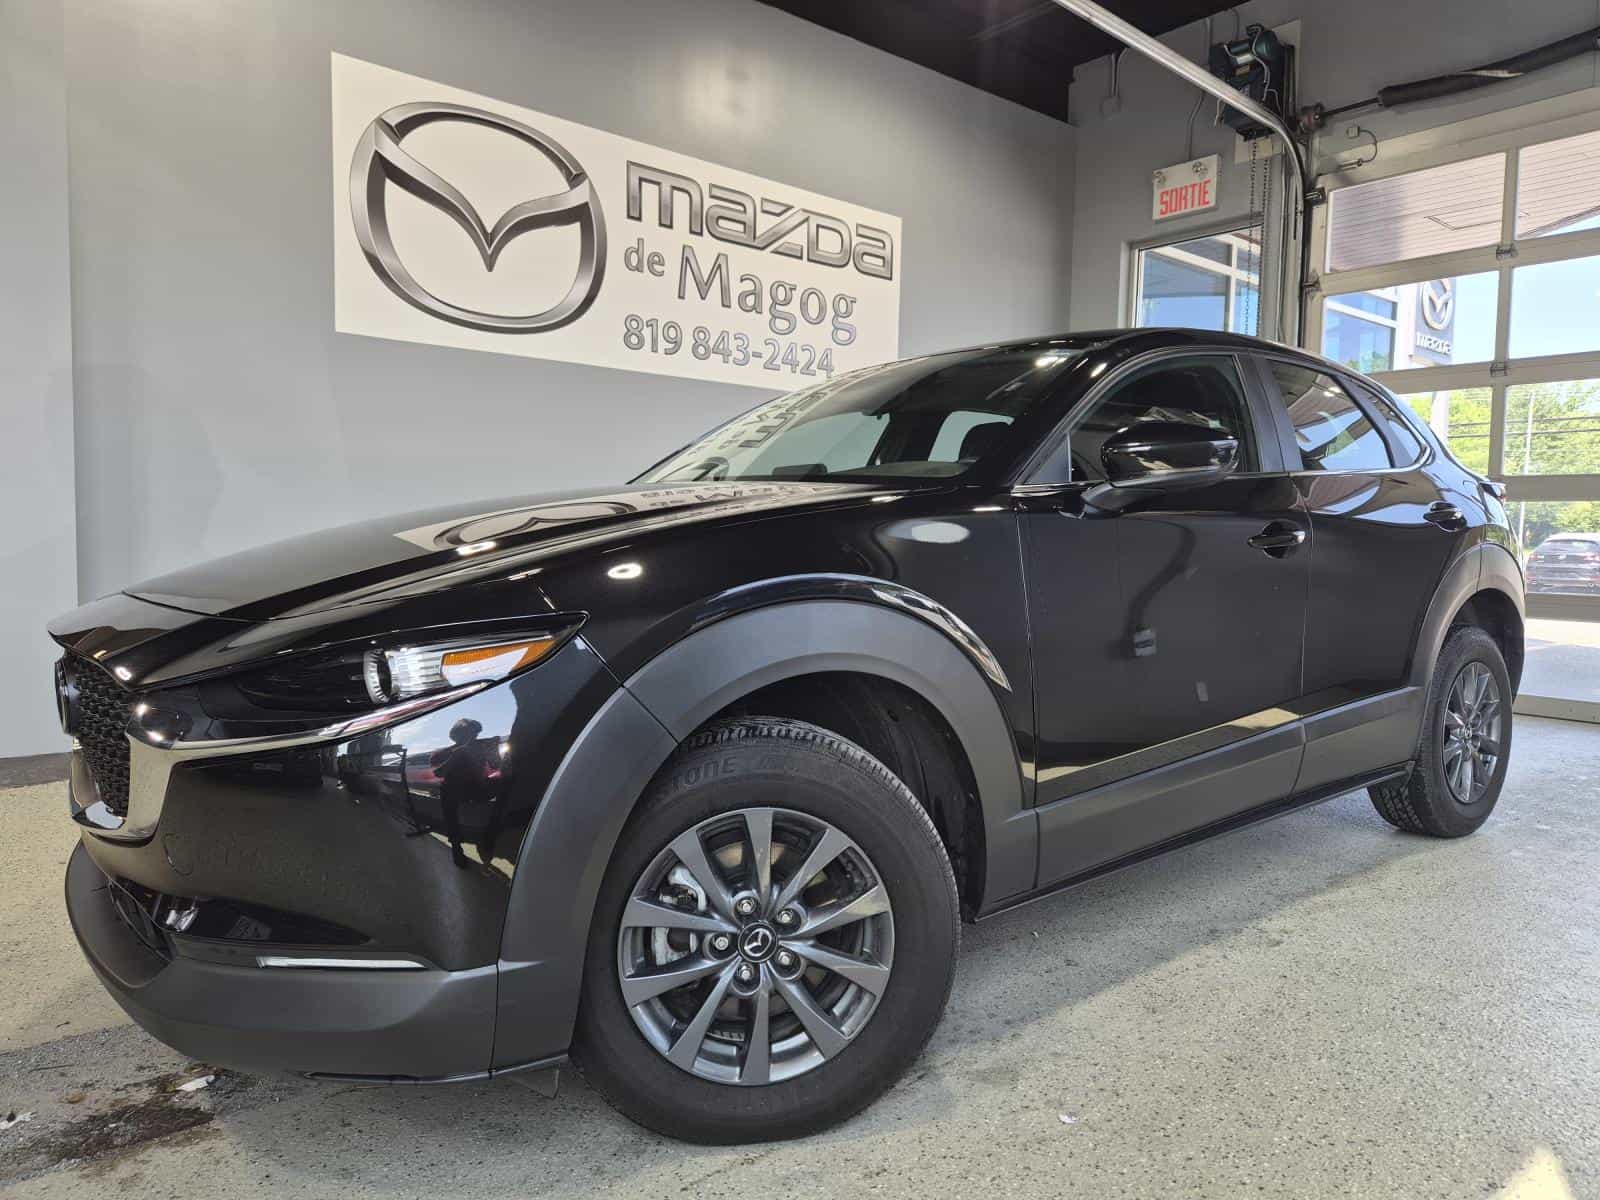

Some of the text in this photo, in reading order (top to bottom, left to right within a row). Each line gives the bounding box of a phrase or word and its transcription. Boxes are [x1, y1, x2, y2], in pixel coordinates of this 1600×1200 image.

[1159, 179, 1211, 216] SORTIE
[624, 238, 857, 345] de Magog
[623, 314, 835, 379] 819 843-2424
